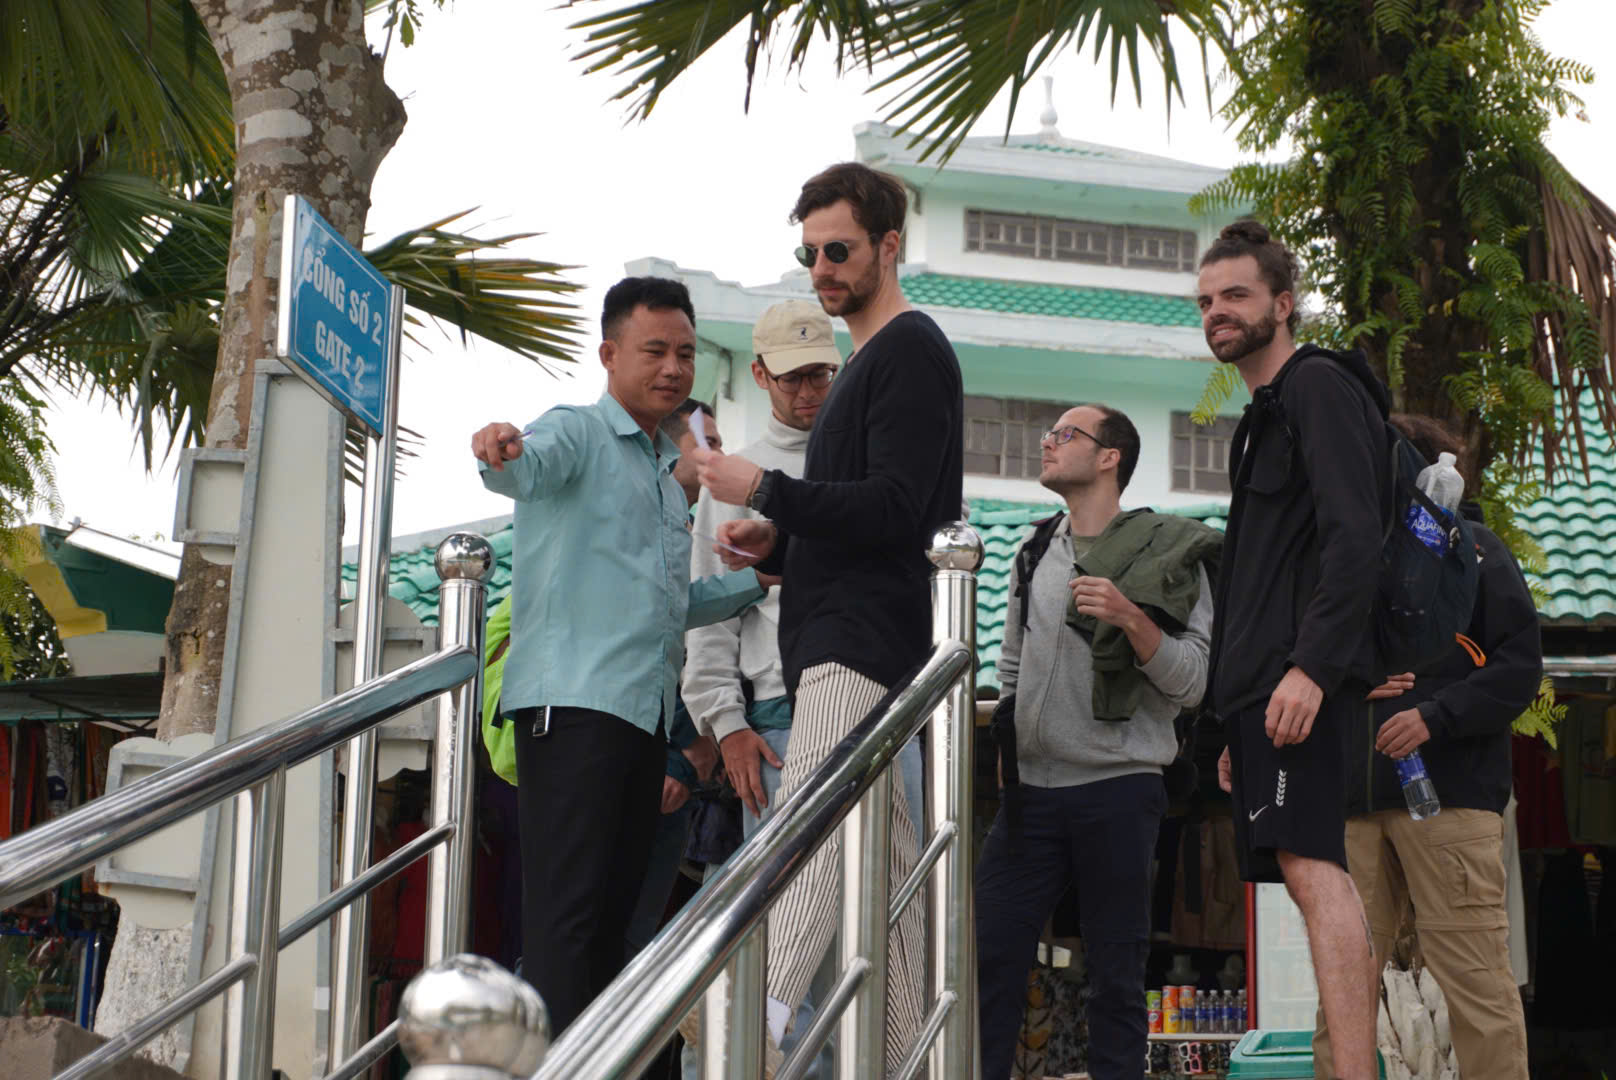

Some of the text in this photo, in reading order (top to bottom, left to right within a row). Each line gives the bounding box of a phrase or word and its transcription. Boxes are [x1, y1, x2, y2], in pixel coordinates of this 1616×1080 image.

[303, 247, 383, 347] CỔNG SỐ 2
[315, 320, 365, 391] GATE 2
